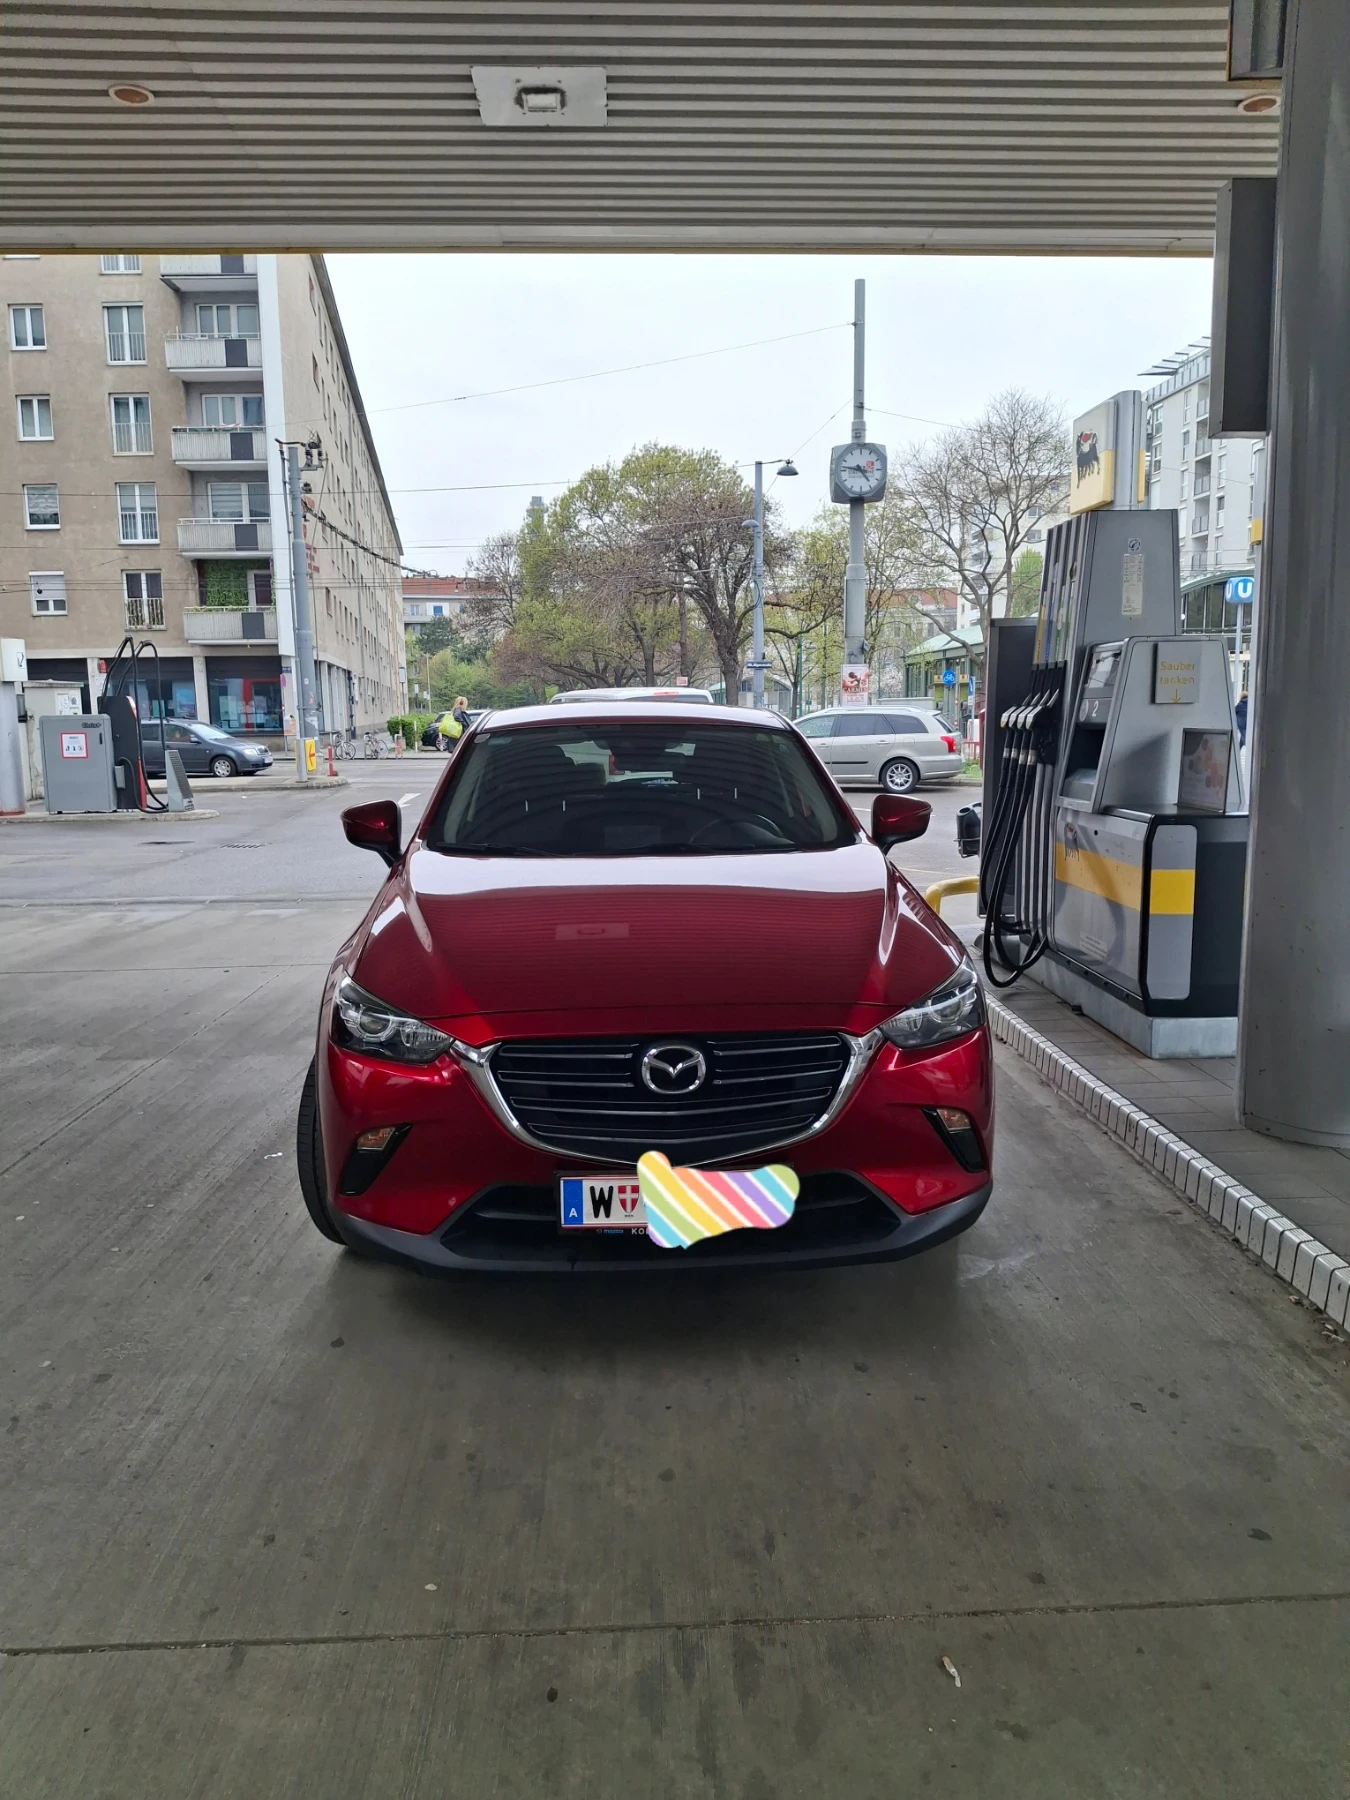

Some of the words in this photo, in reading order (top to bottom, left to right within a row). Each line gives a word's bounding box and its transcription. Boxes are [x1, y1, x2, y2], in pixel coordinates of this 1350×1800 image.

[1238, 582, 1253, 599] U
[1160, 660, 1196, 671] Sauber
[1092, 701, 1099, 717] 2
[590, 1186, 613, 1218] W
[569, 1208, 578, 1217] A
